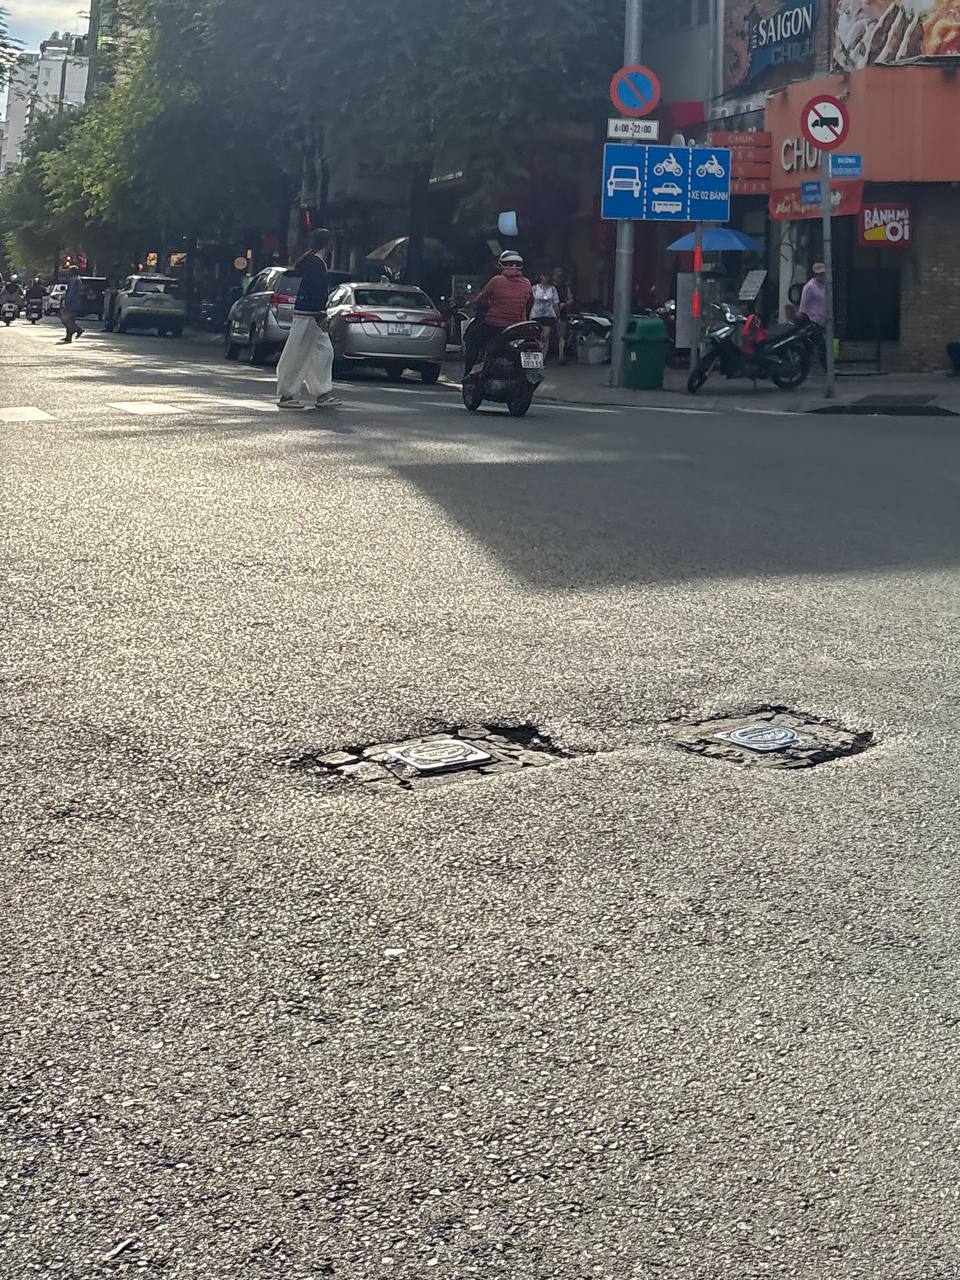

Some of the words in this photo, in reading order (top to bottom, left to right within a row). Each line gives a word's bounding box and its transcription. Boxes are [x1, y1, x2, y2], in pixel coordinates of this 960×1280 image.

[758, 3, 813, 47] SAIGON
[781, 137, 822, 172] CHU
[691, 190, 700, 200] XE
[700, 191, 709, 200] 02
